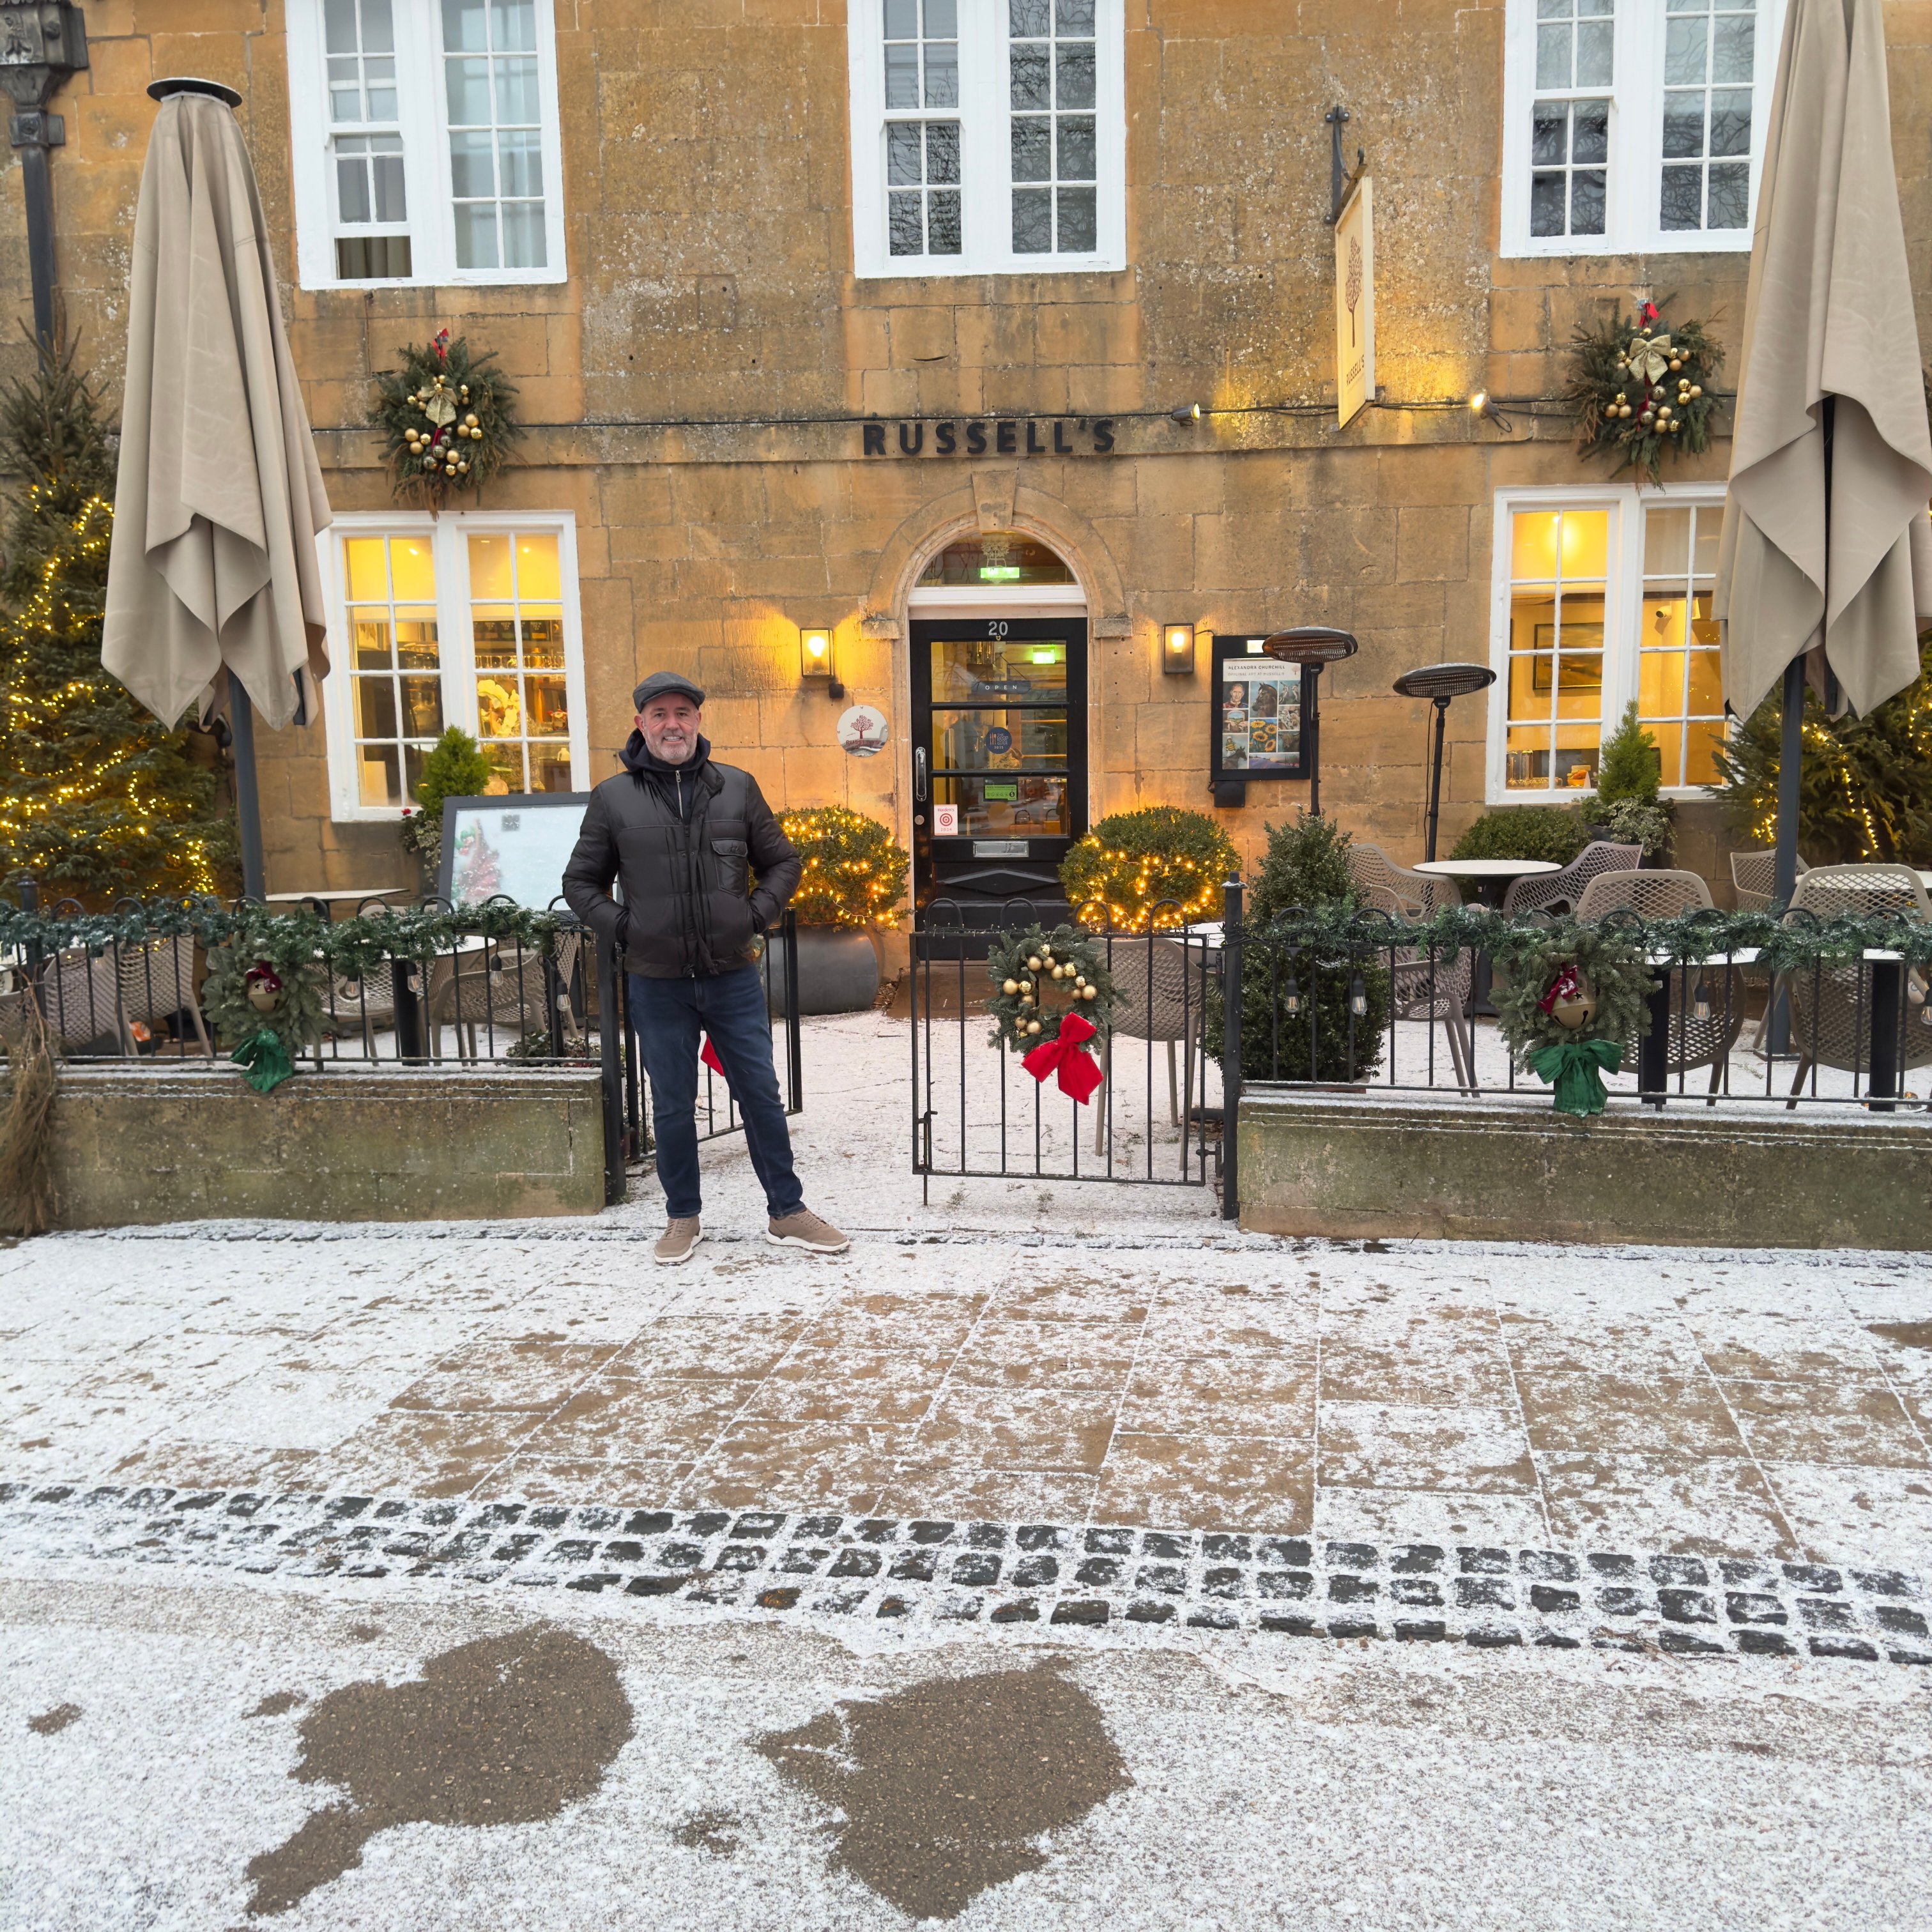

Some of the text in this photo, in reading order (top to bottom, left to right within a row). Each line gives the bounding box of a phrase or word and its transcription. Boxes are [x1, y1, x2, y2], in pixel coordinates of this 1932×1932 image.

[1346, 354, 1364, 386] RUSSELL'S
[863, 420, 1114, 456] RUSSELL'S
[988, 621, 1008, 636] 20
